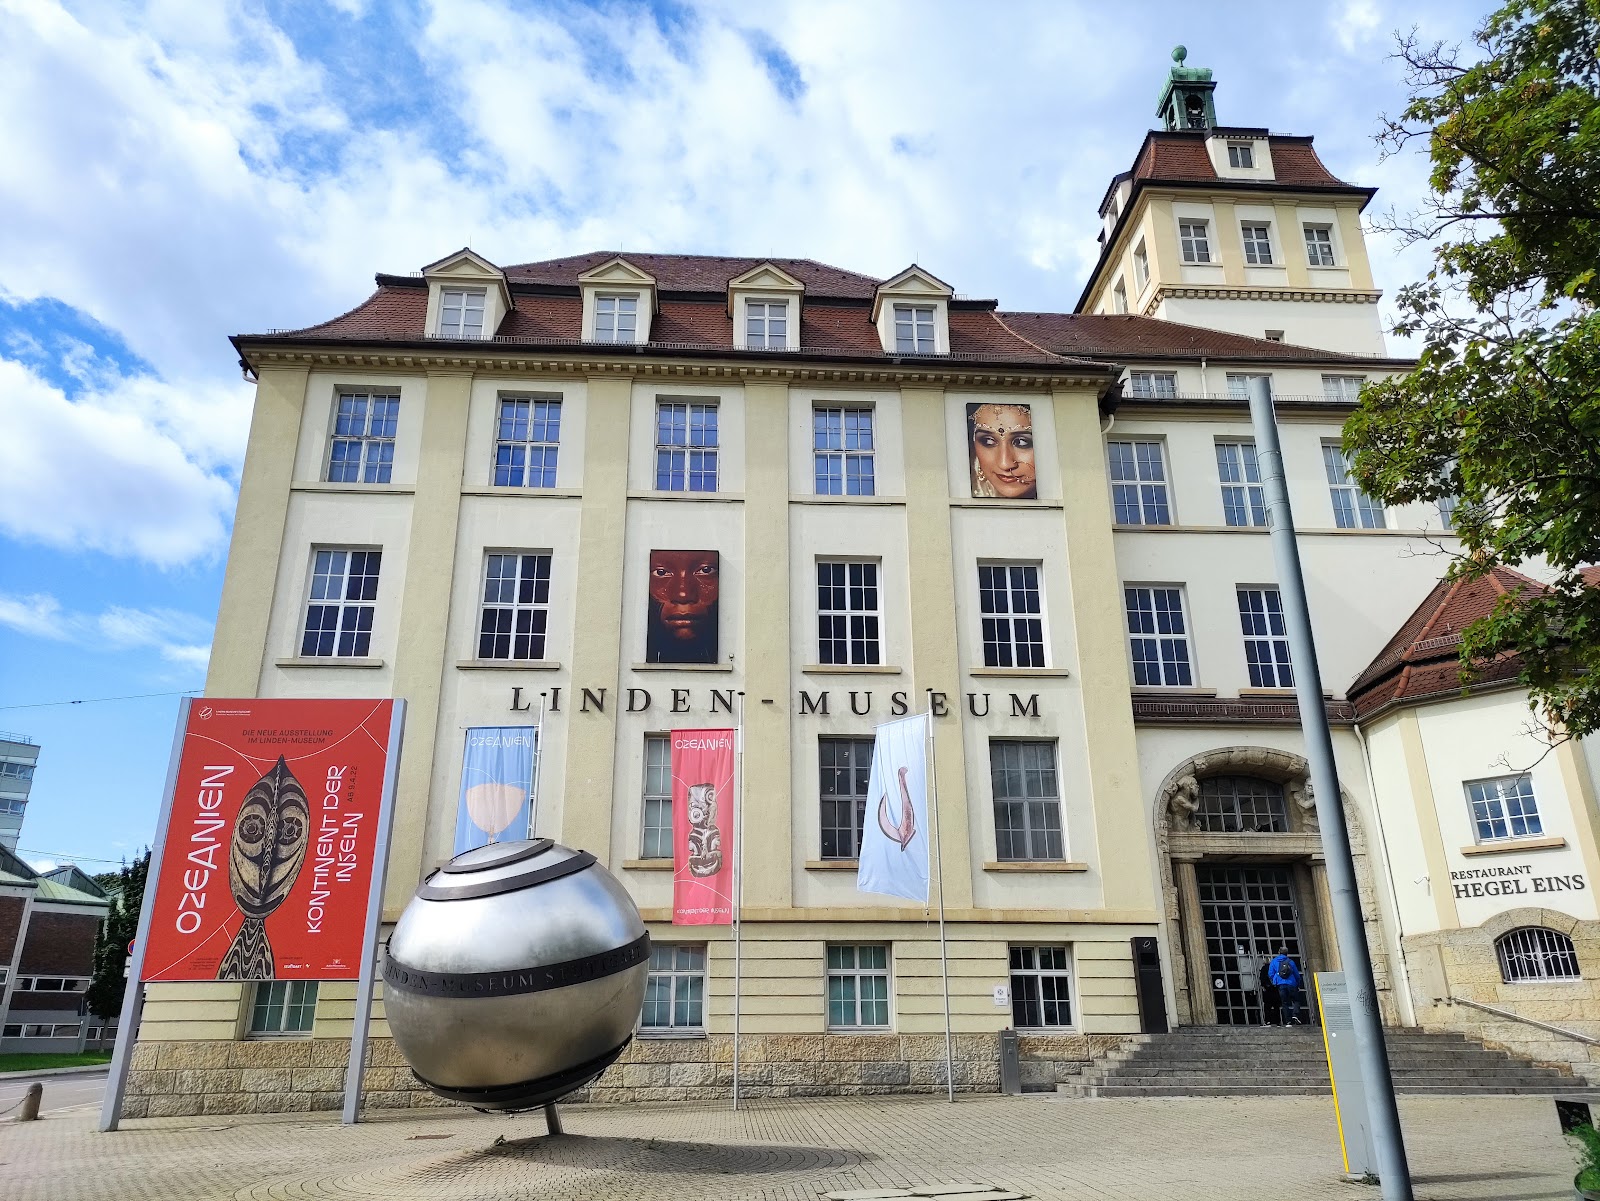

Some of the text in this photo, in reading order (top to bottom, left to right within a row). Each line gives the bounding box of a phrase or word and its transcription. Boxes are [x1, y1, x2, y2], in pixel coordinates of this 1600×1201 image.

[242, 729, 334, 737] DIE NEUE AUSSTELLUNG
[470, 735, 532, 748] OZEANIEN
[674, 737, 732, 751] OZEANIEN
[322, 765, 348, 810] DER
[346, 765, 358, 803] AB 9.4.22
[175, 765, 235, 934] OZEANIEN
[335, 812, 364, 882] INSELN
[306, 814, 340, 933] KONTINENT
[1450, 865, 1533, 880] RESTAURANT
[1453, 874, 1586, 898] HEGEL EINS
